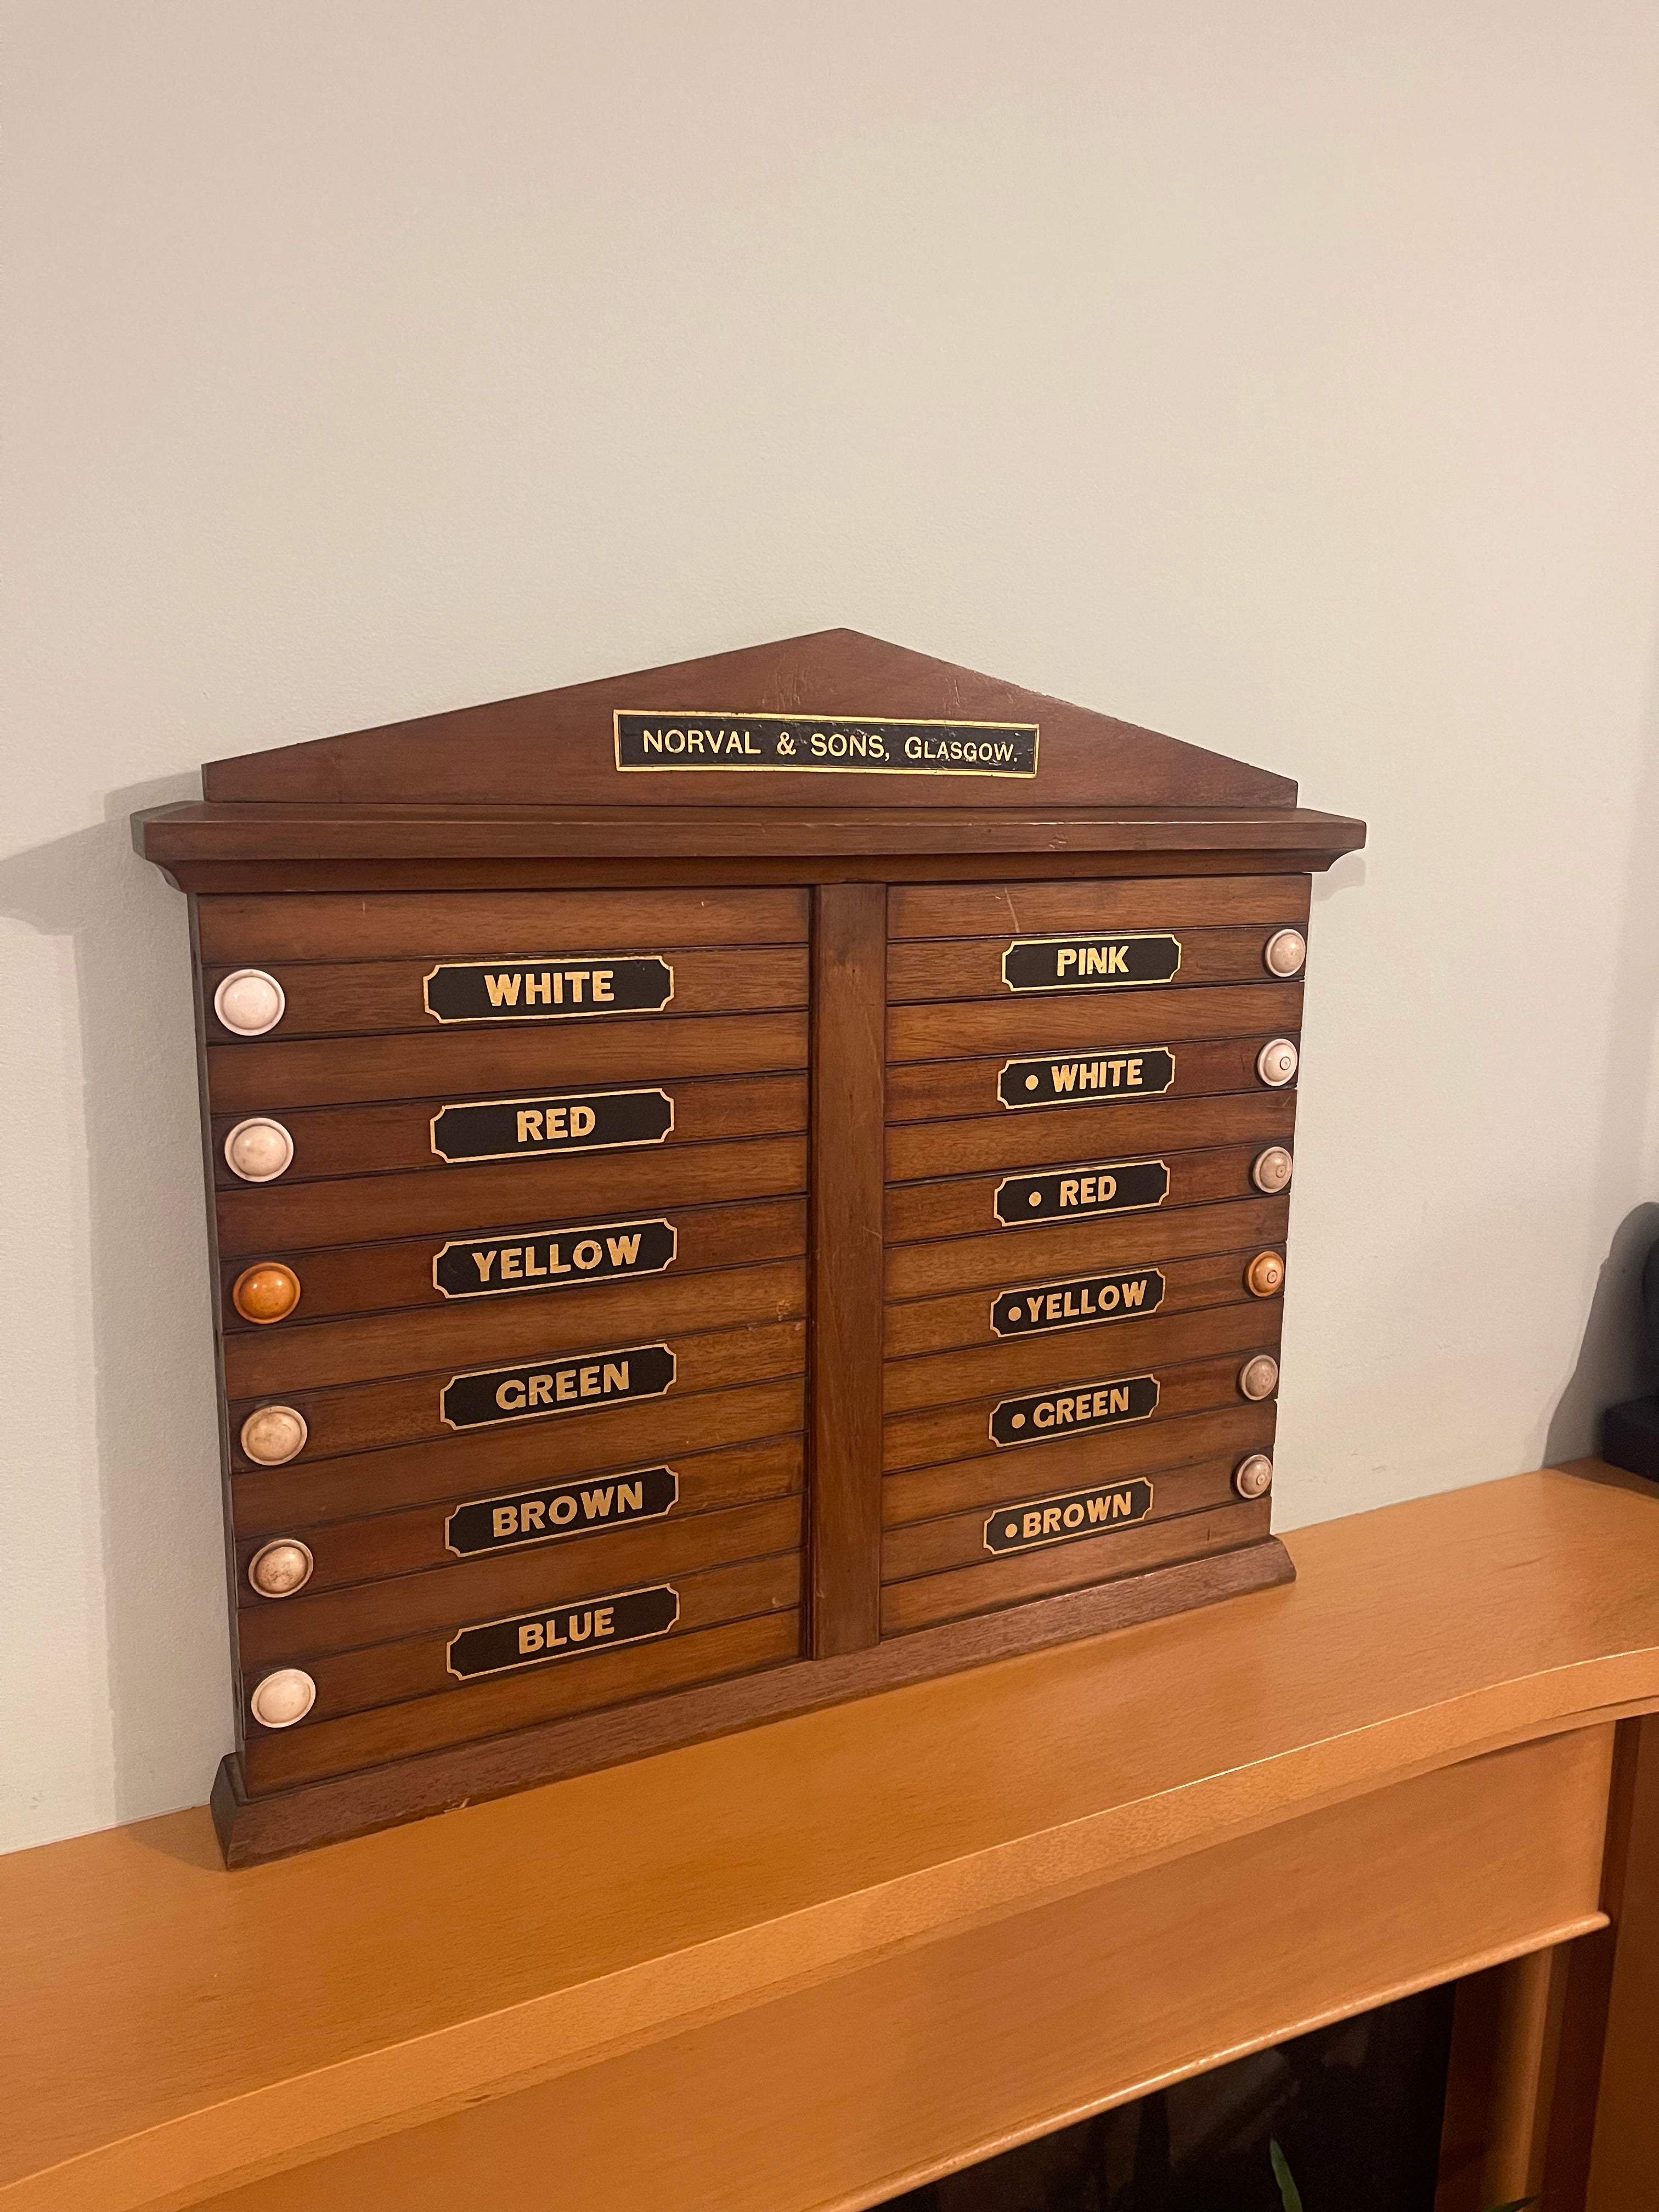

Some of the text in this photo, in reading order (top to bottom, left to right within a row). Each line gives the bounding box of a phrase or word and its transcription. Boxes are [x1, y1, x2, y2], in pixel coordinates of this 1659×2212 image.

[643, 729, 761, 754] NORVAL
[777, 732, 797, 755] &
[811, 733, 890, 761] SONS,
[1057, 945, 1130, 977] PINK
[484, 970, 614, 1007] WHITE
[1051, 1059, 1143, 1092] WHITE
[517, 1105, 596, 1142] RED
[1059, 1175, 1116, 1207] RED
[472, 1233, 641, 1282] YELLOW
[1026, 1279, 1147, 1322] YELLOW
[495, 1361, 629, 1410] GREEN
[1033, 1386, 1129, 1428] GREEN
[493, 1481, 642, 1537] BROWN
[1023, 1491, 1131, 1538] BROWN
[518, 1607, 614, 1654] BLUE
